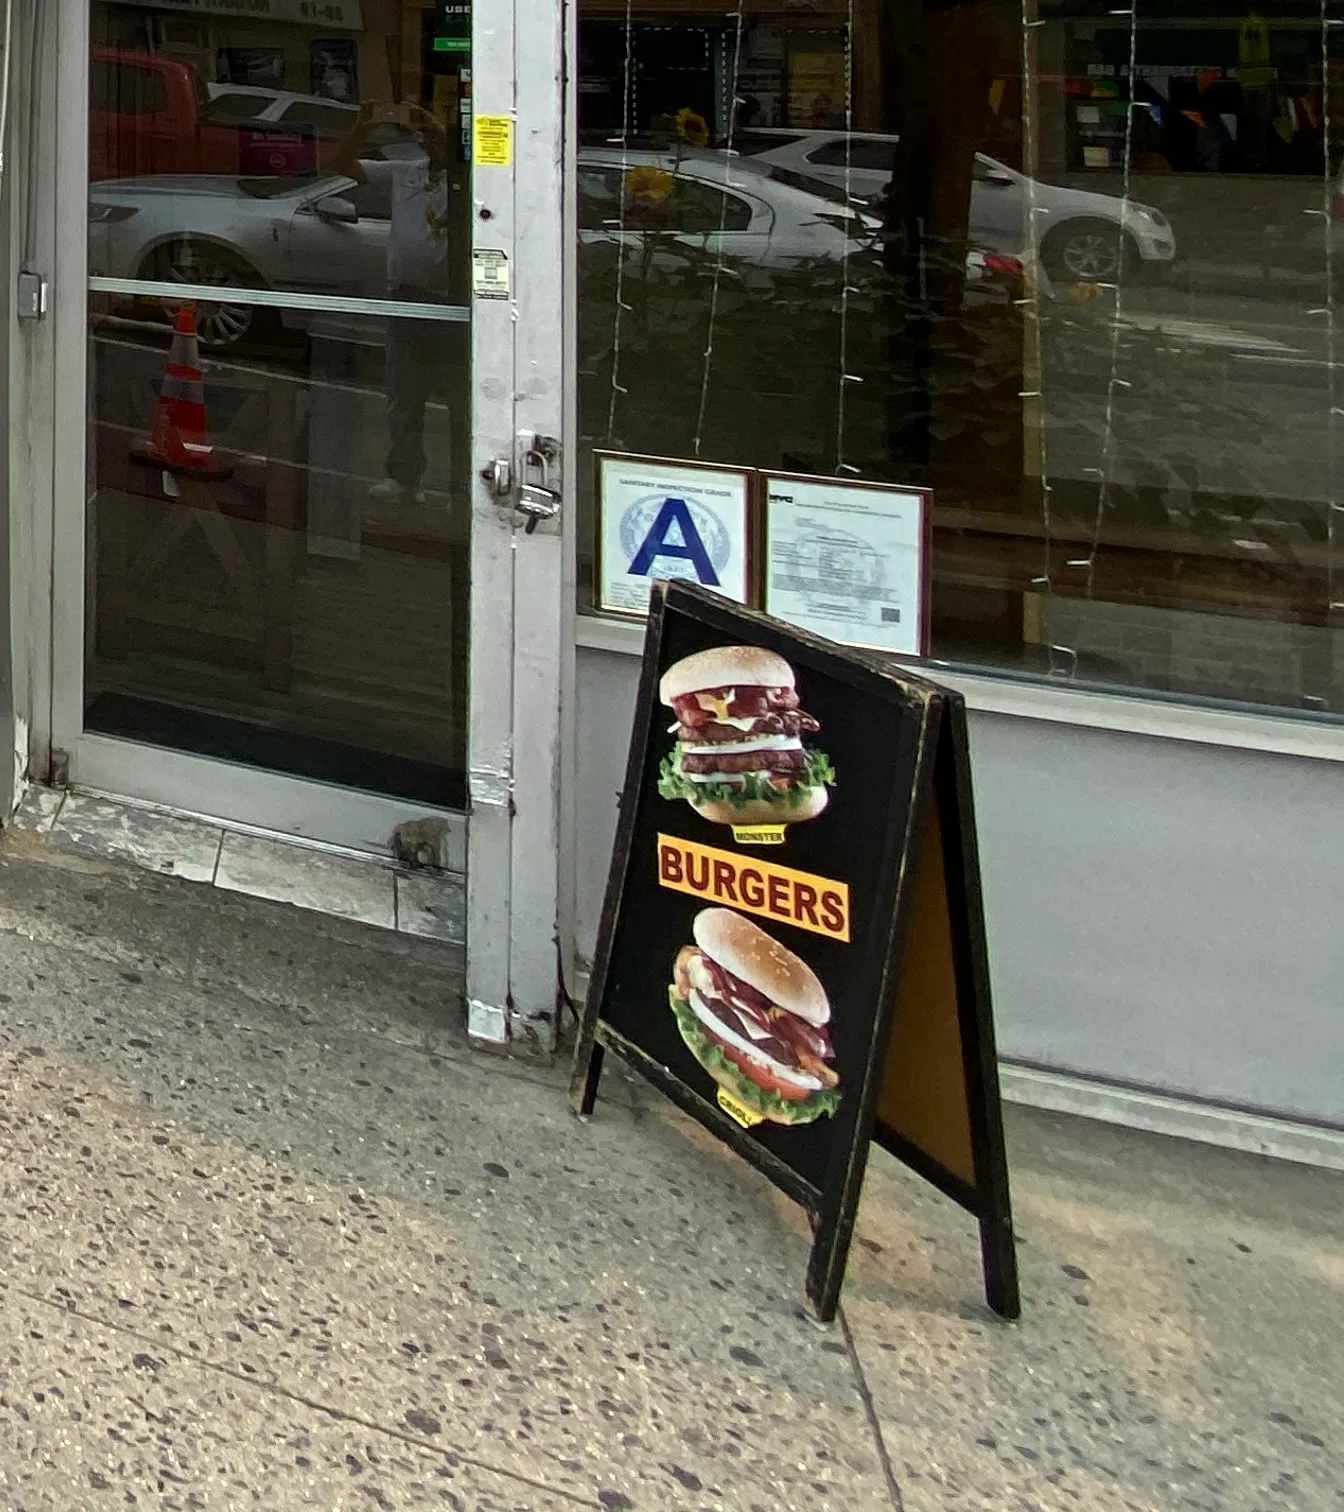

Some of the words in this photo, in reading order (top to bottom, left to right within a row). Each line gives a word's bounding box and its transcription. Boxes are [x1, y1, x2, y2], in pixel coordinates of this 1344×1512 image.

[445, 5, 471, 14] UBE
[626, 497, 722, 588] A
[661, 845, 846, 933] BURGERS
